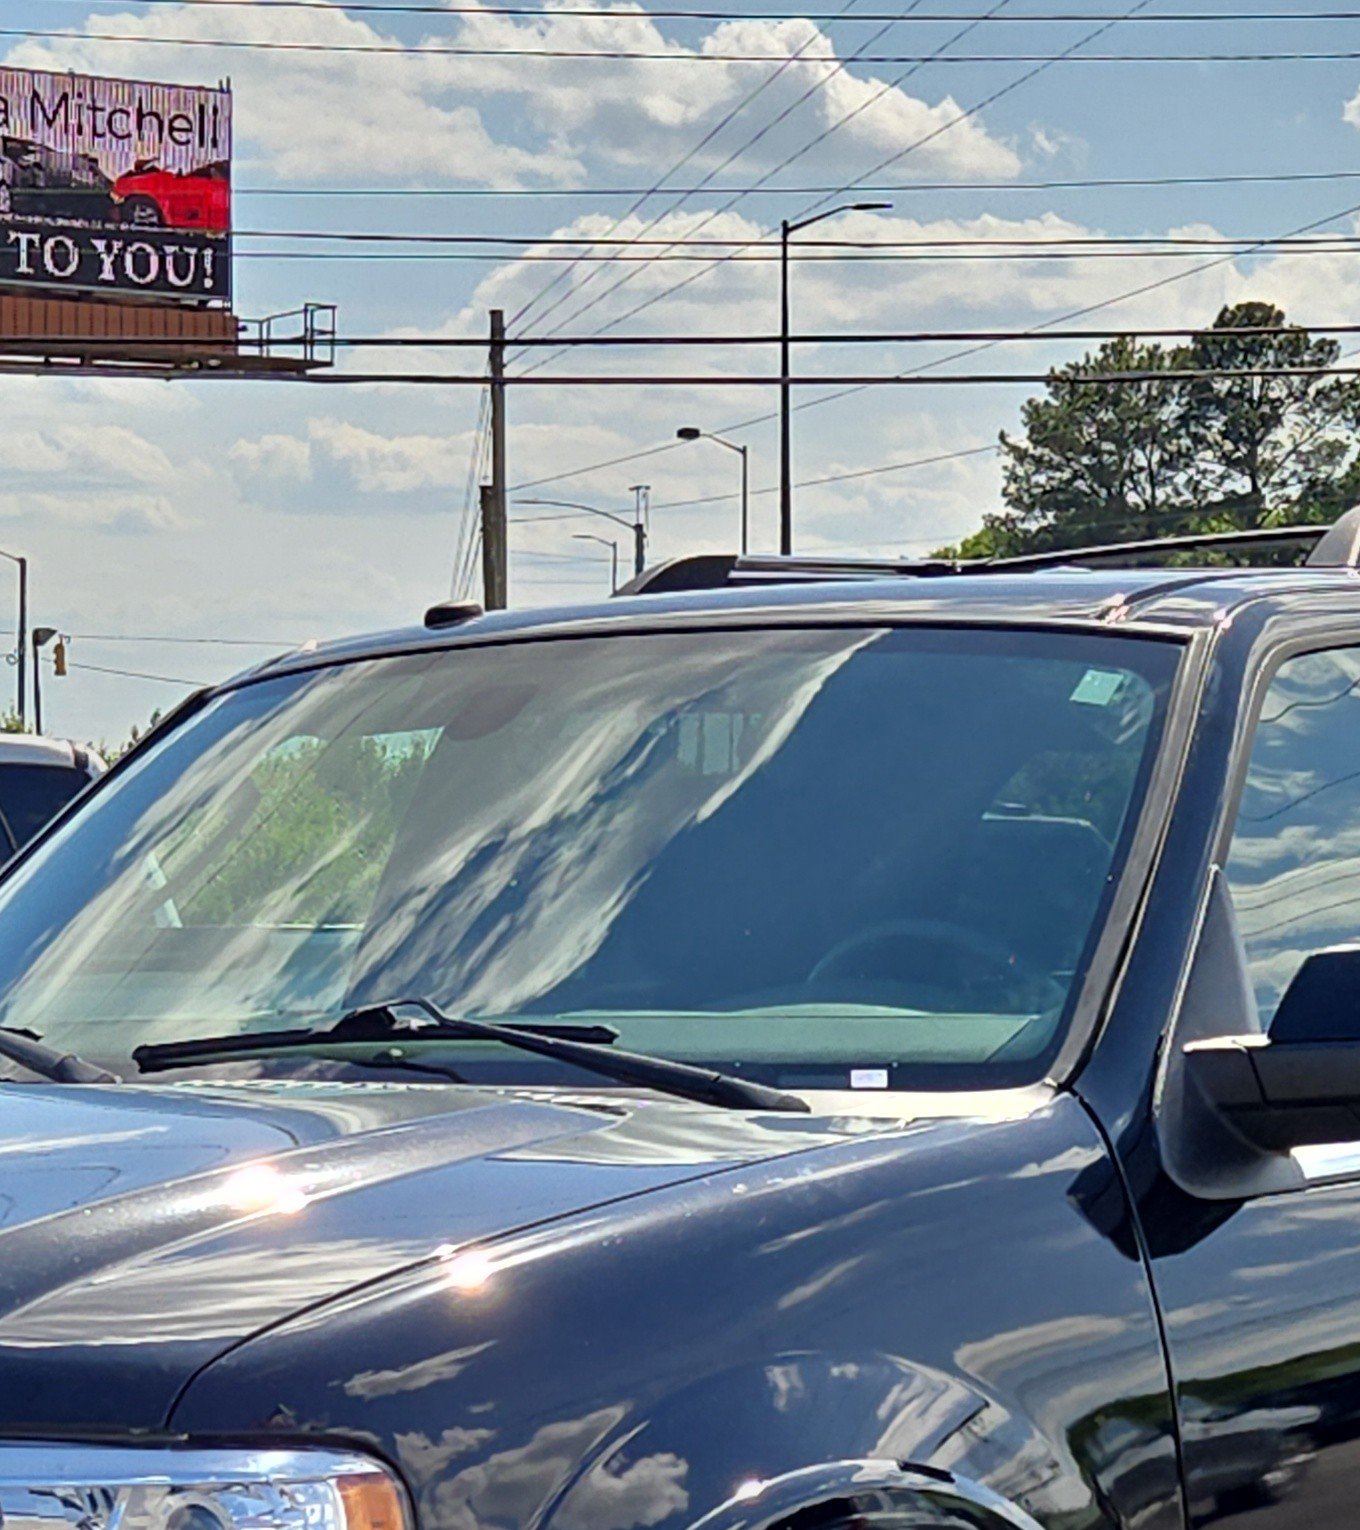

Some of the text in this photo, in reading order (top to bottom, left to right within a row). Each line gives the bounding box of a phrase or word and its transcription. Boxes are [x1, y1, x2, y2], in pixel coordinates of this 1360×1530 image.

[31, 88, 219, 148] Mitchell
[7, 229, 80, 278] TO
[90, 237, 216, 289] YOU!
